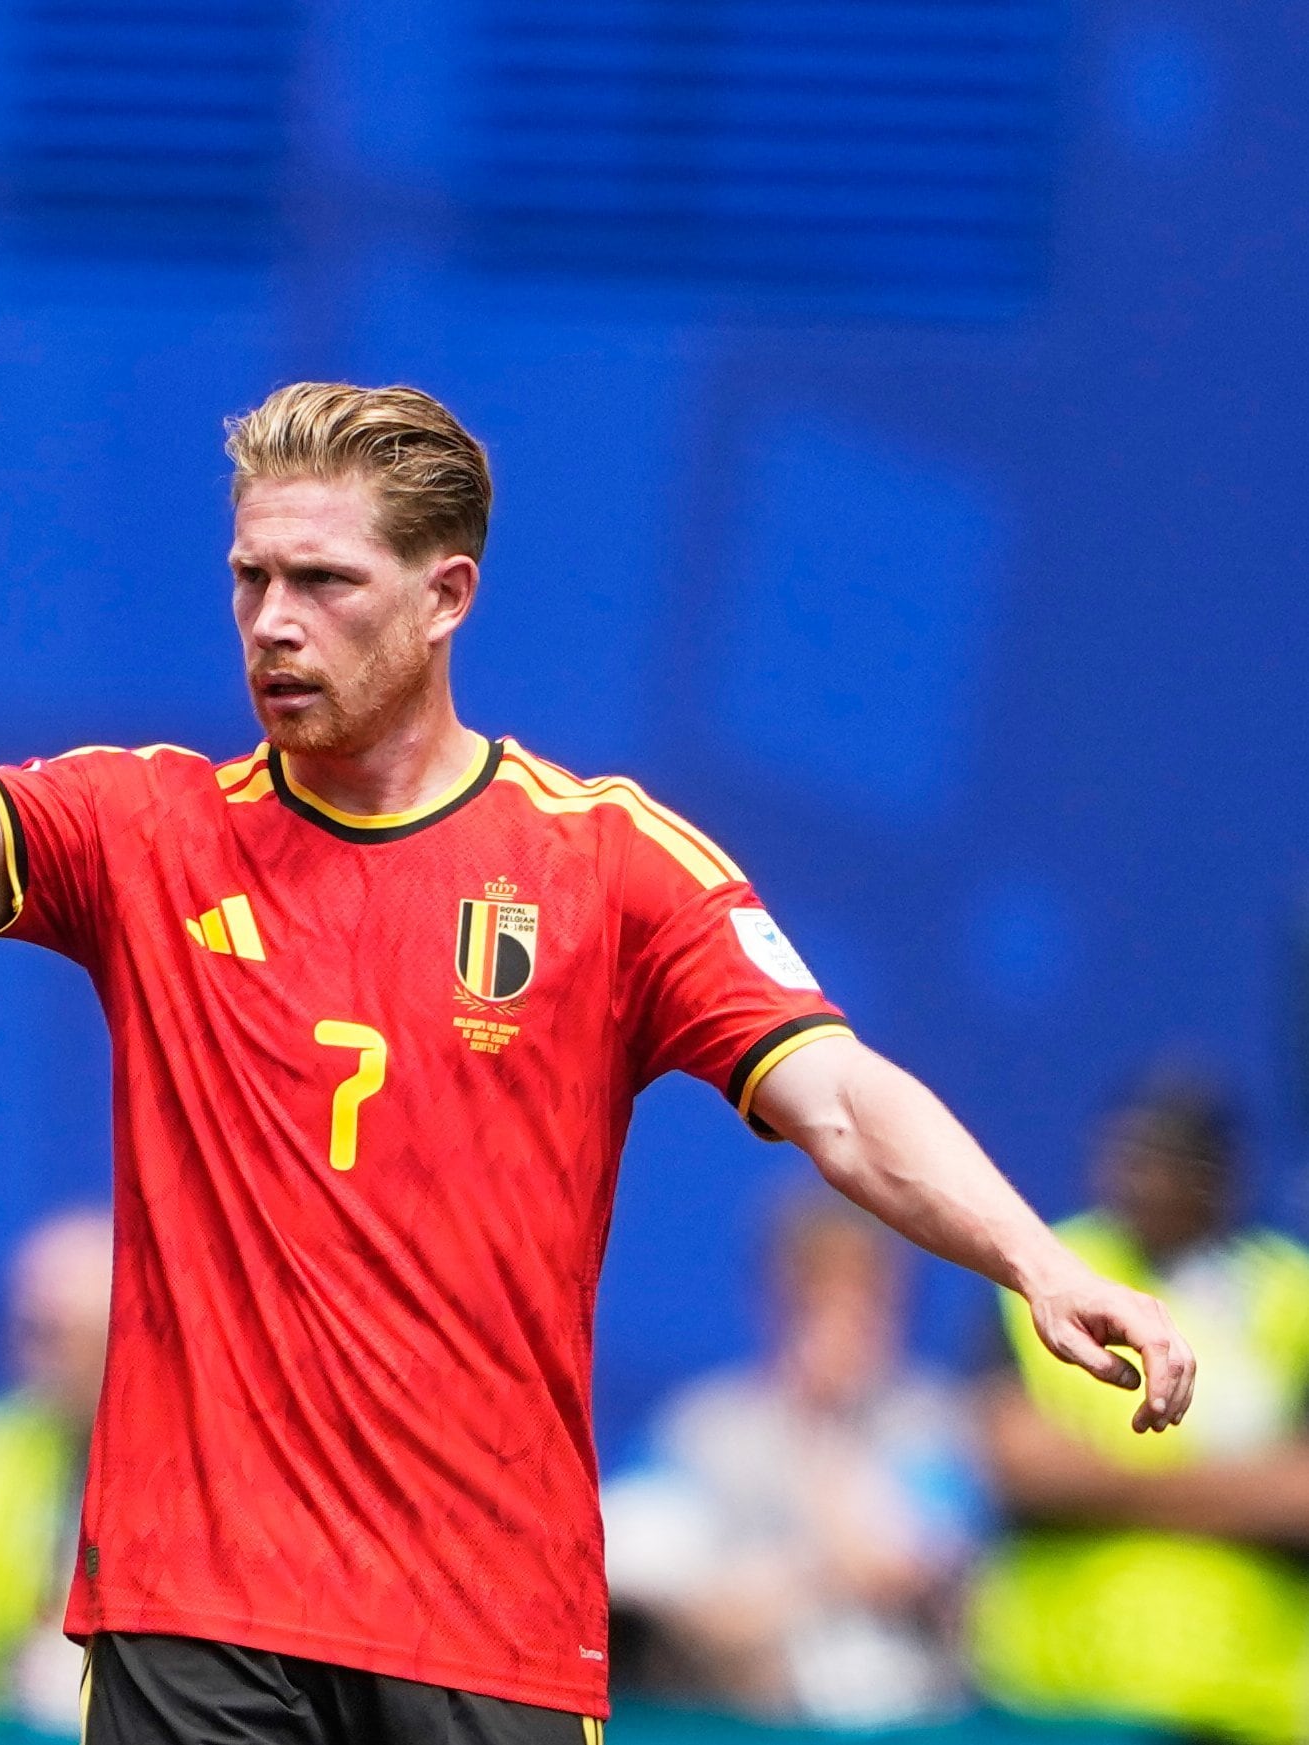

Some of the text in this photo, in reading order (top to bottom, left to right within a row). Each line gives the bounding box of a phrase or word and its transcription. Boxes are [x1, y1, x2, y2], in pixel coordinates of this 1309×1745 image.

[499, 905, 526, 915] ROYAL
[499, 914, 535, 924] BELGIAN
[314, 1019, 387, 1171] 7
